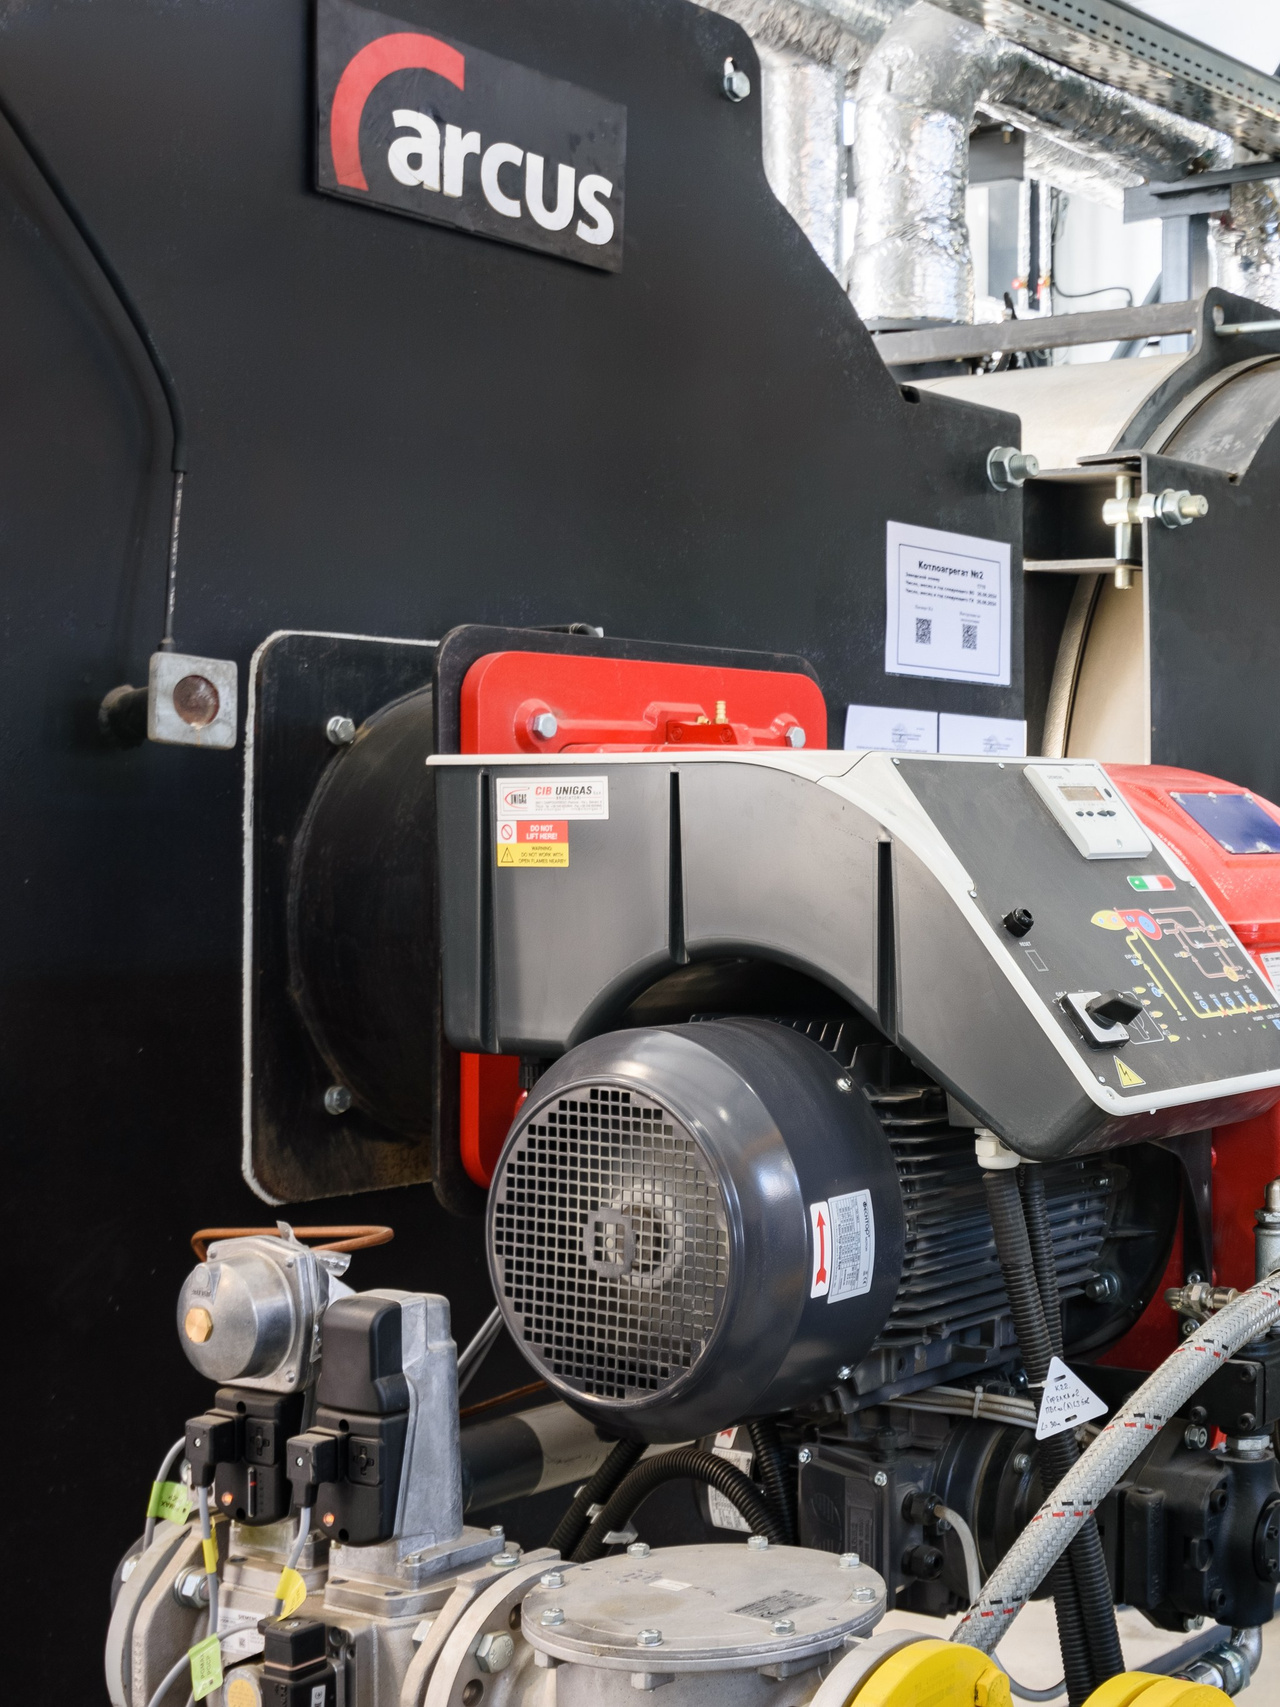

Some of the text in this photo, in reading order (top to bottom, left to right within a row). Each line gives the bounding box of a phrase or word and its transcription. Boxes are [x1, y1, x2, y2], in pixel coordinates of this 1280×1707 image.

[388, 109, 614, 245] arcus
[918, 560, 984, 580] Котлоагрегат №2
[535, 785, 592, 796] CIB UNIGAS
[510, 793, 527, 805] UNIGAS
[530, 824, 553, 832] DO NOT
